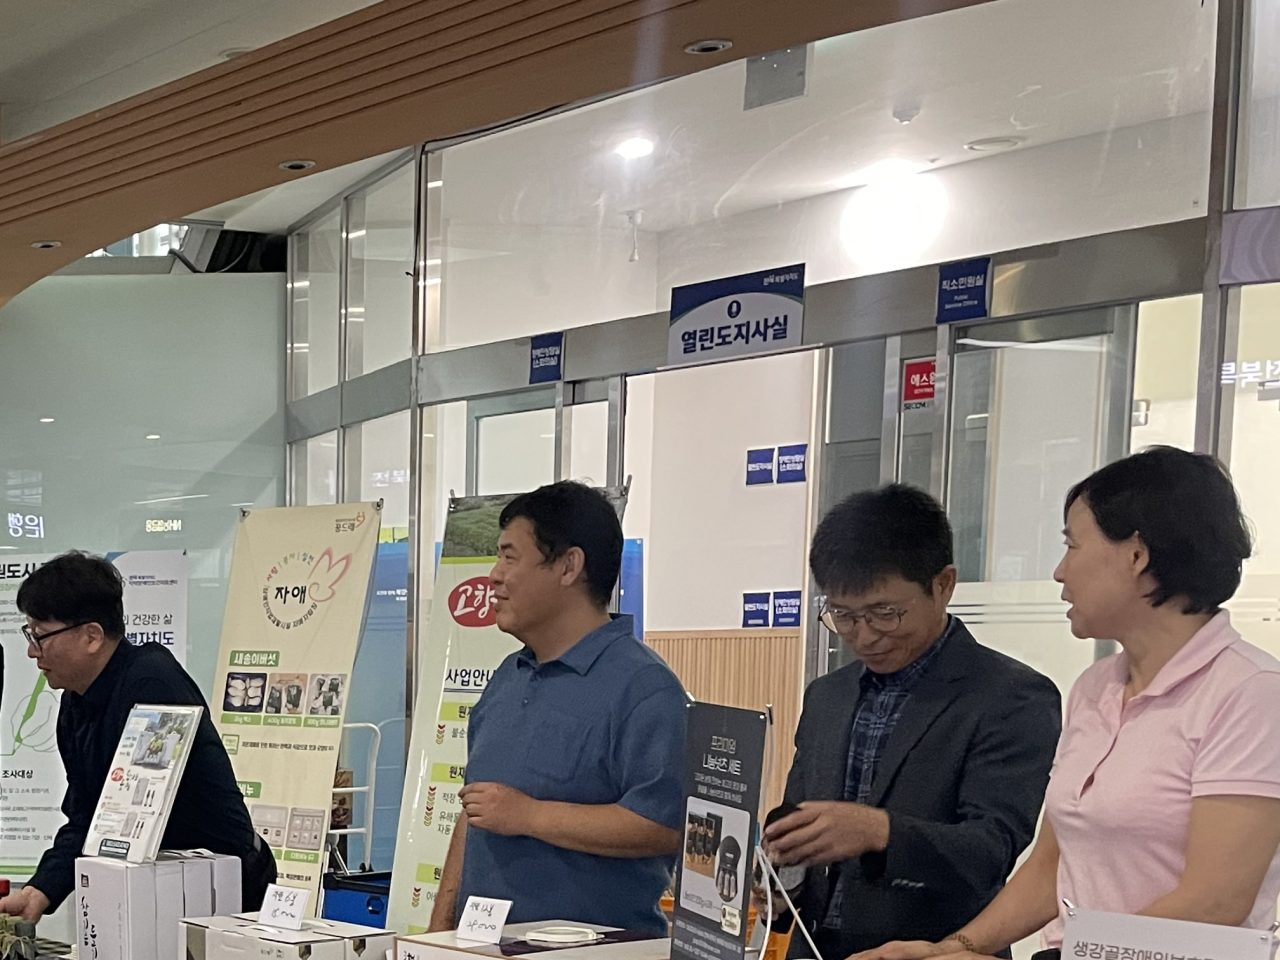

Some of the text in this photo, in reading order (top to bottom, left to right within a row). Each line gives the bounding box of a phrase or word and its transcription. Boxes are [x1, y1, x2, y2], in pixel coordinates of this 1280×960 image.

[942, 274, 984, 291] 직소민원실
[681, 314, 788, 354] 열린도지사실
[275, 586, 307, 605] 자애
[132, 614, 160, 625] 건강한
[2, 769, 34, 779] 조사대상
